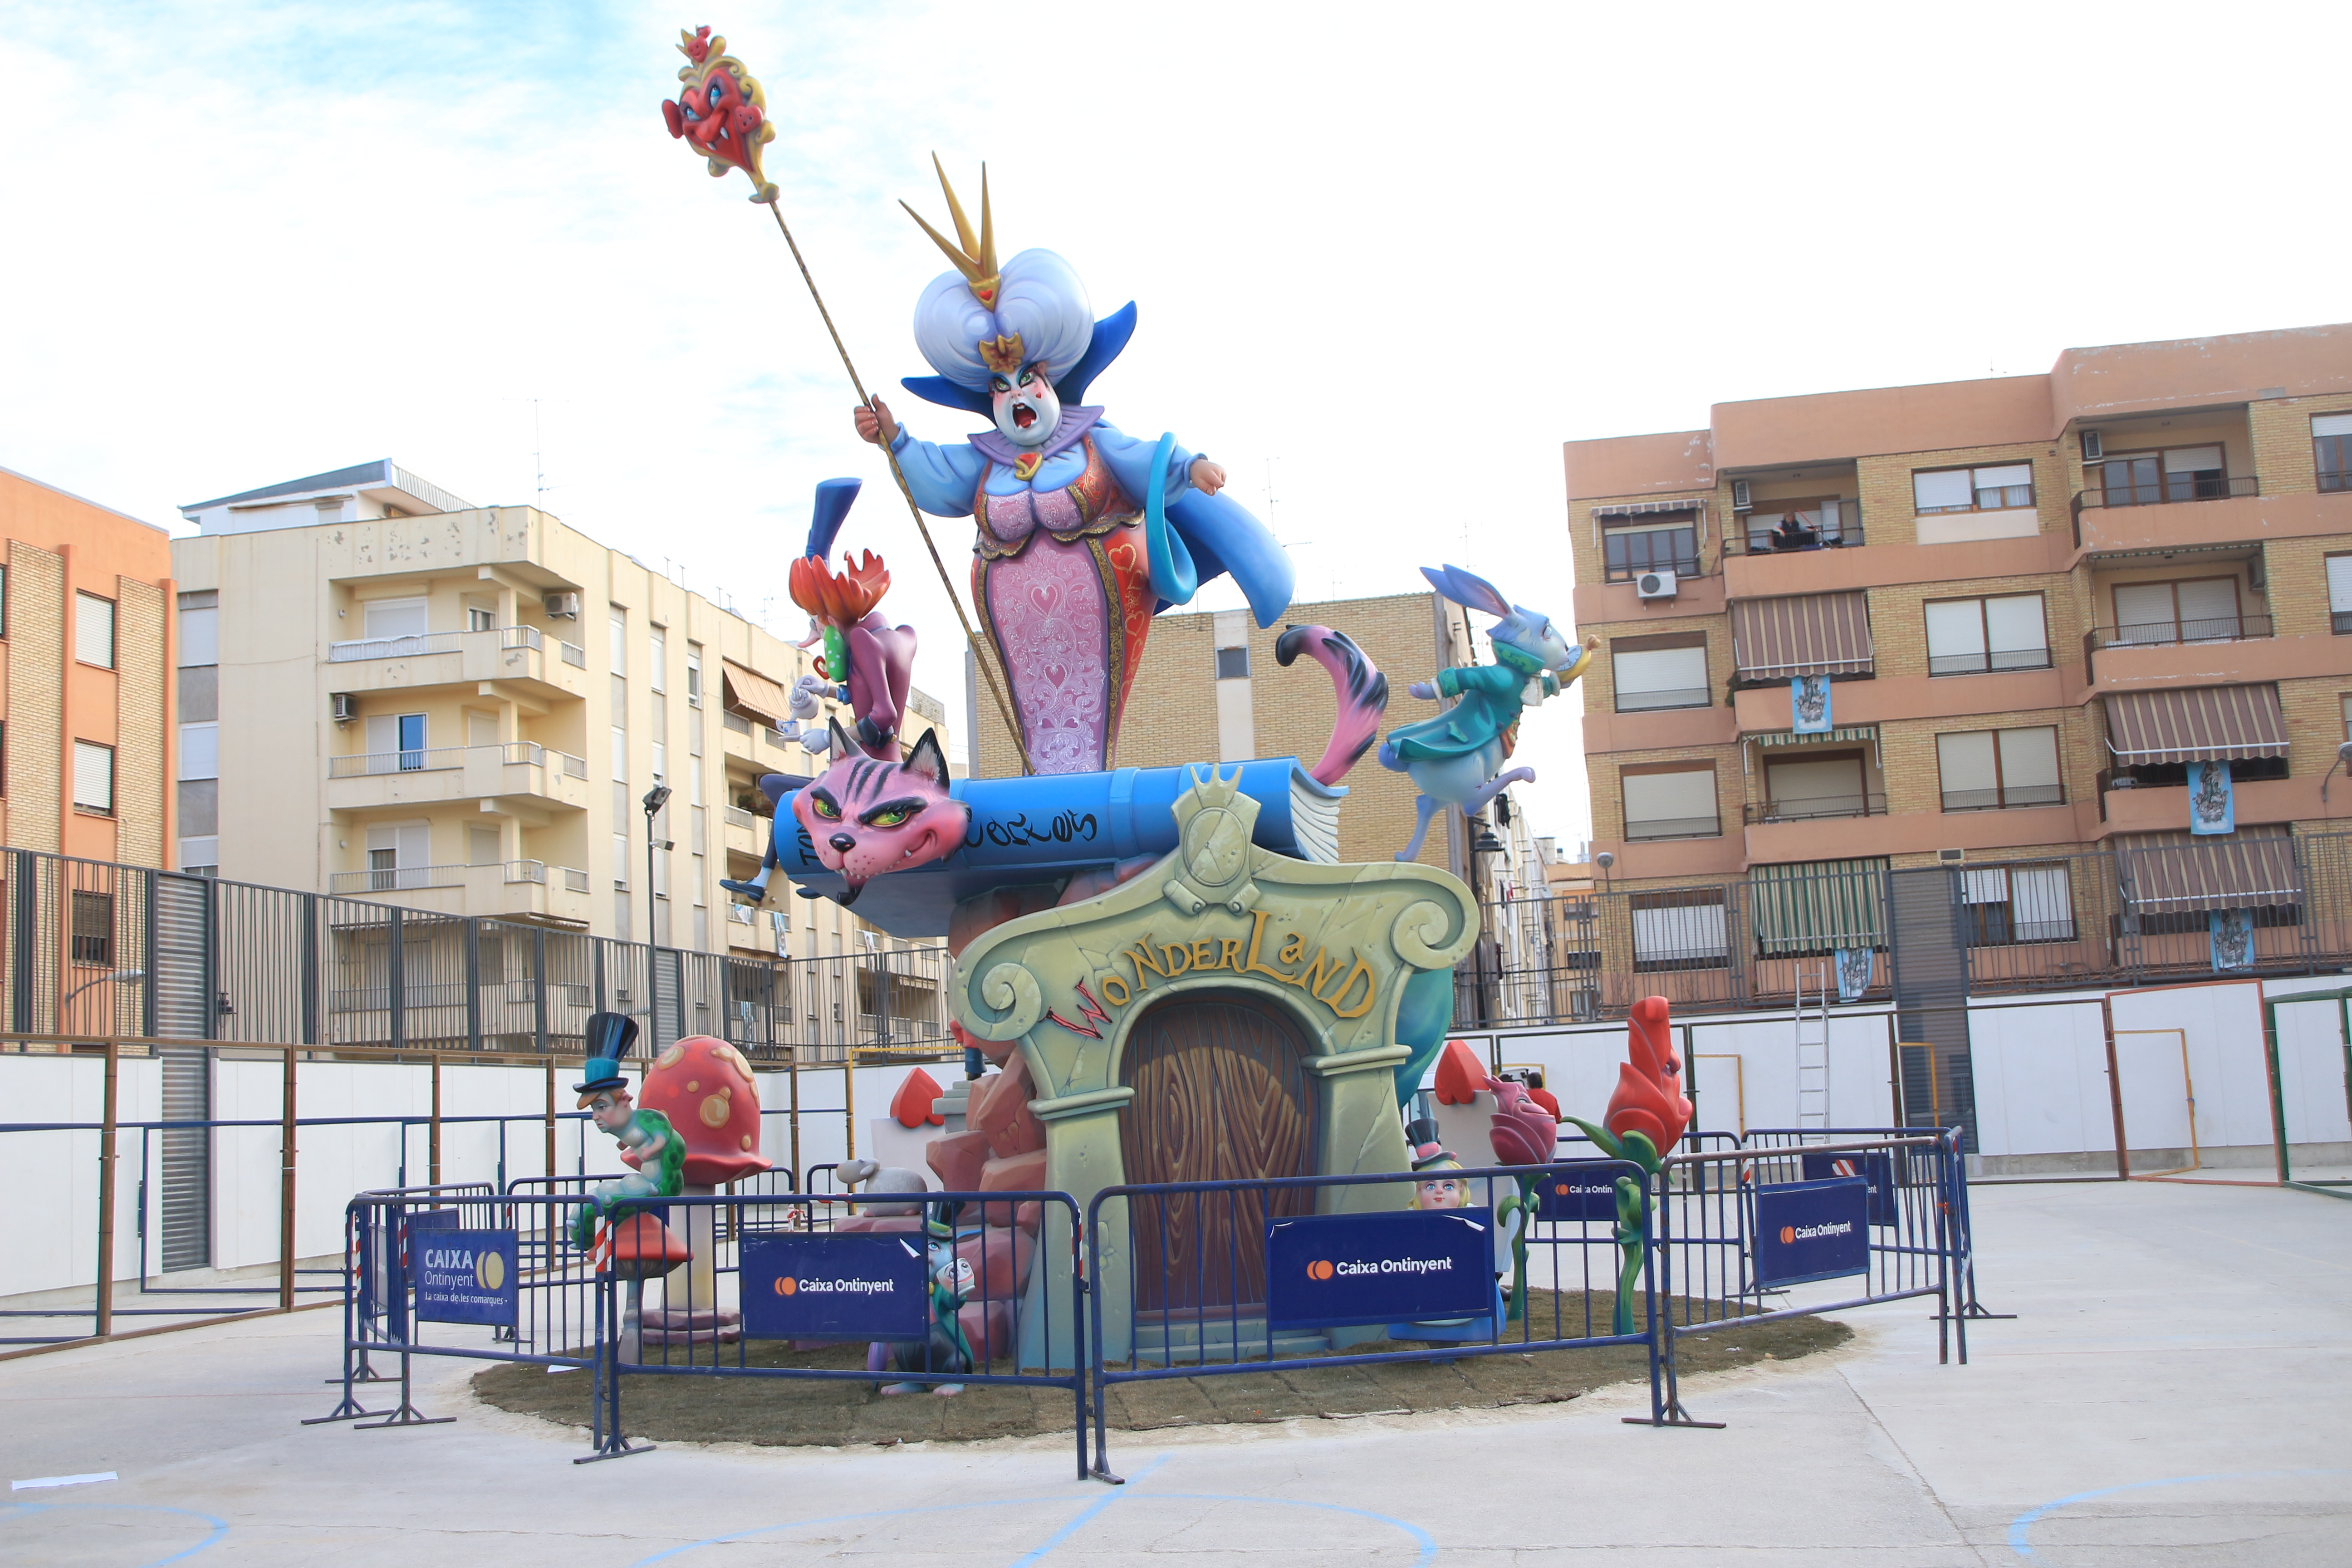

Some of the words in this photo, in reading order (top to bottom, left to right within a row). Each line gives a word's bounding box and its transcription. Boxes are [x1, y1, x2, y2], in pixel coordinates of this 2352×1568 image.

[1569, 1185, 1591, 1193] Caia
[1592, 1185, 1612, 1193] Ontin
[1795, 1225, 1817, 1239] Caixa
[1817, 1220, 1851, 1236] Ontinyent
[425, 1249, 474, 1269] CAIXA
[1337, 1259, 1378, 1275] Caixa
[1381, 1256, 1451, 1274] Ontinyent
[425, 1271, 474, 1290] Ontinyent
[799, 1277, 833, 1292] Caixa
[835, 1277, 894, 1295] Ontinyent
[433, 1292, 448, 1301] caixa
[451, 1293, 459, 1302] de
[461, 1293, 469, 1303] les
[470, 1295, 503, 1307] comarques
